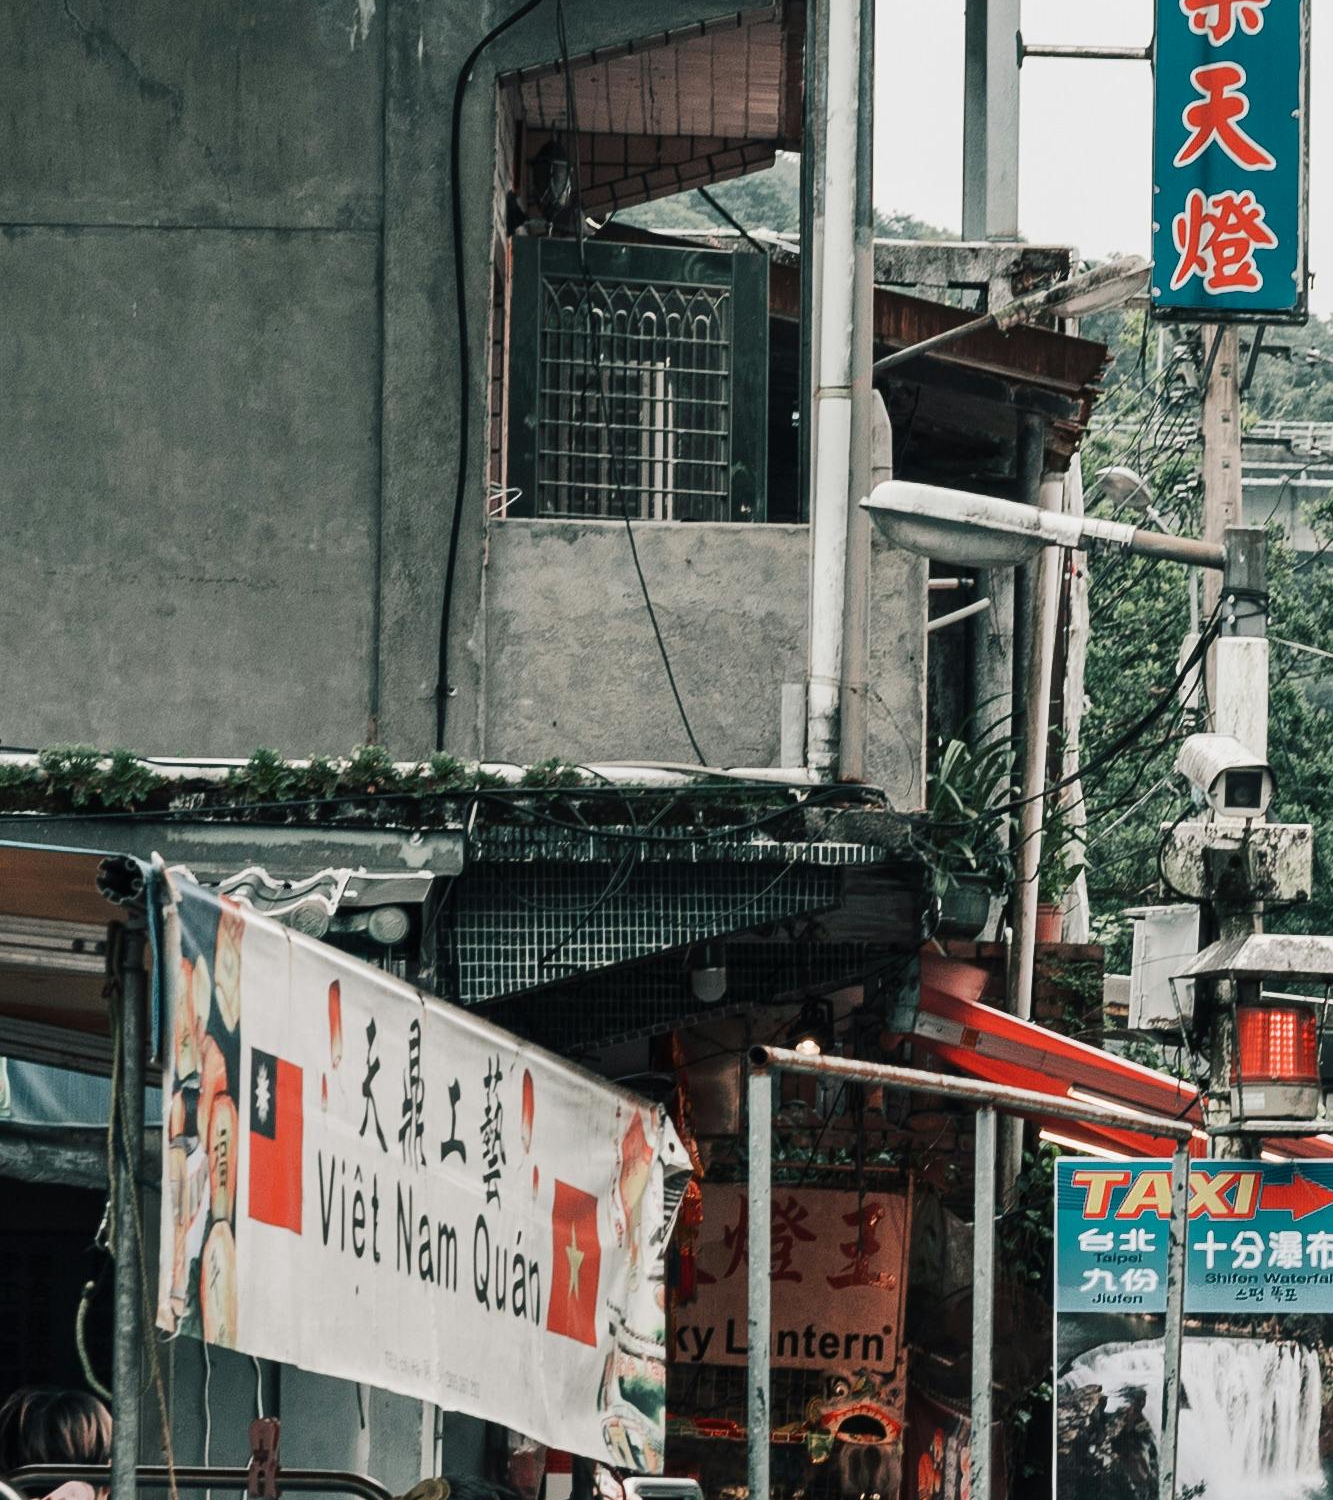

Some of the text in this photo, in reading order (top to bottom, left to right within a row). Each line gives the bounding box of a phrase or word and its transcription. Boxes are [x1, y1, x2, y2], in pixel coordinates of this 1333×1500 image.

[1073, 1171, 1261, 1220] TAXI
[1078, 1228, 1156, 1252] 台北
[397, 1179, 457, 1294] Nam
[472, 1212, 542, 1329] Quán
[1094, 1253, 1142, 1265] Taipei
[1079, 1268, 1160, 1293] 九份
[1092, 1292, 1143, 1304] Jiufen
[725, 1318, 884, 1361] Lntern
